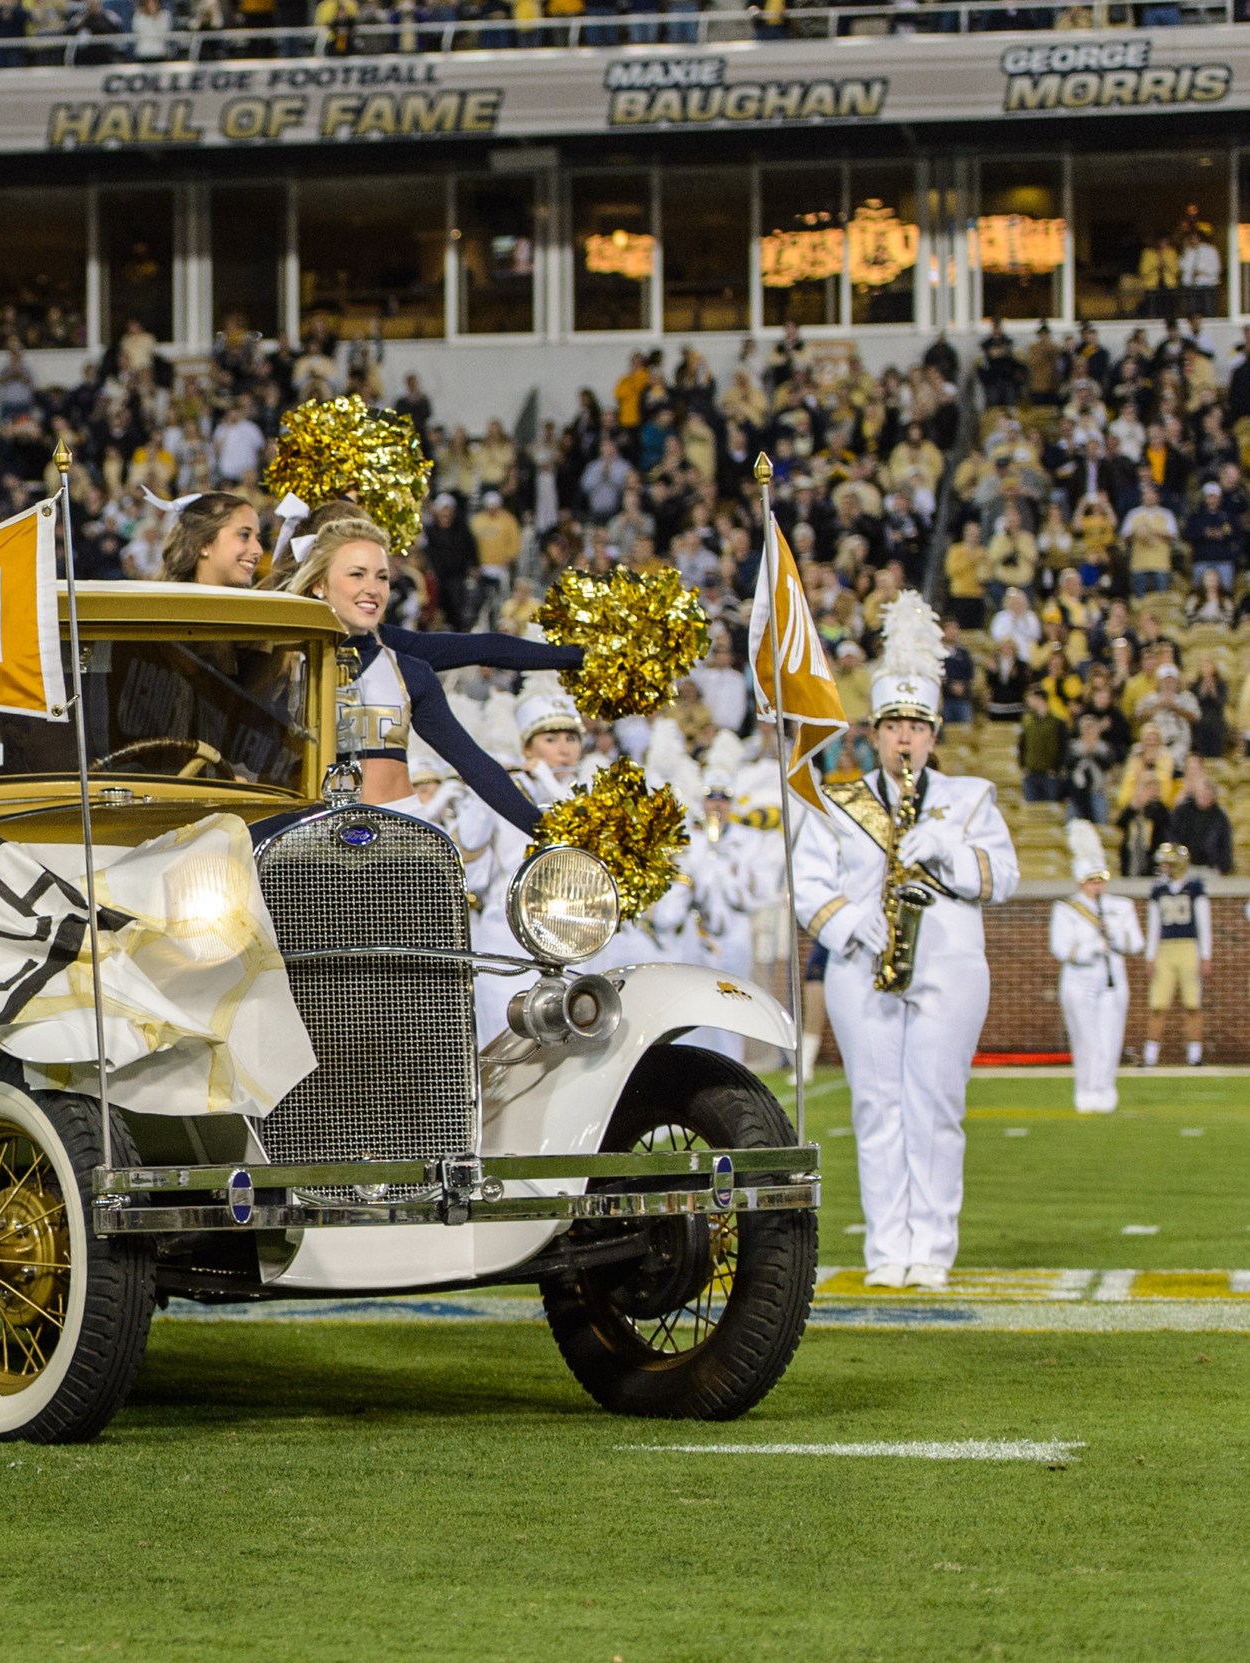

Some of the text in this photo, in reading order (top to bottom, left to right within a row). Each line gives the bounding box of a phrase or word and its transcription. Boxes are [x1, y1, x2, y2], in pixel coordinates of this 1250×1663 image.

[605, 56, 726, 88] MAXIE
[1003, 40, 1152, 73] GEORGE
[102, 62, 439, 95] COLLEGE FOOTBALL
[1005, 63, 1232, 111] MORRIS
[50, 88, 505, 146] HALL OF FAME
[610, 77, 889, 124] BAUGHAN
[344, 828, 372, 840] Ford
